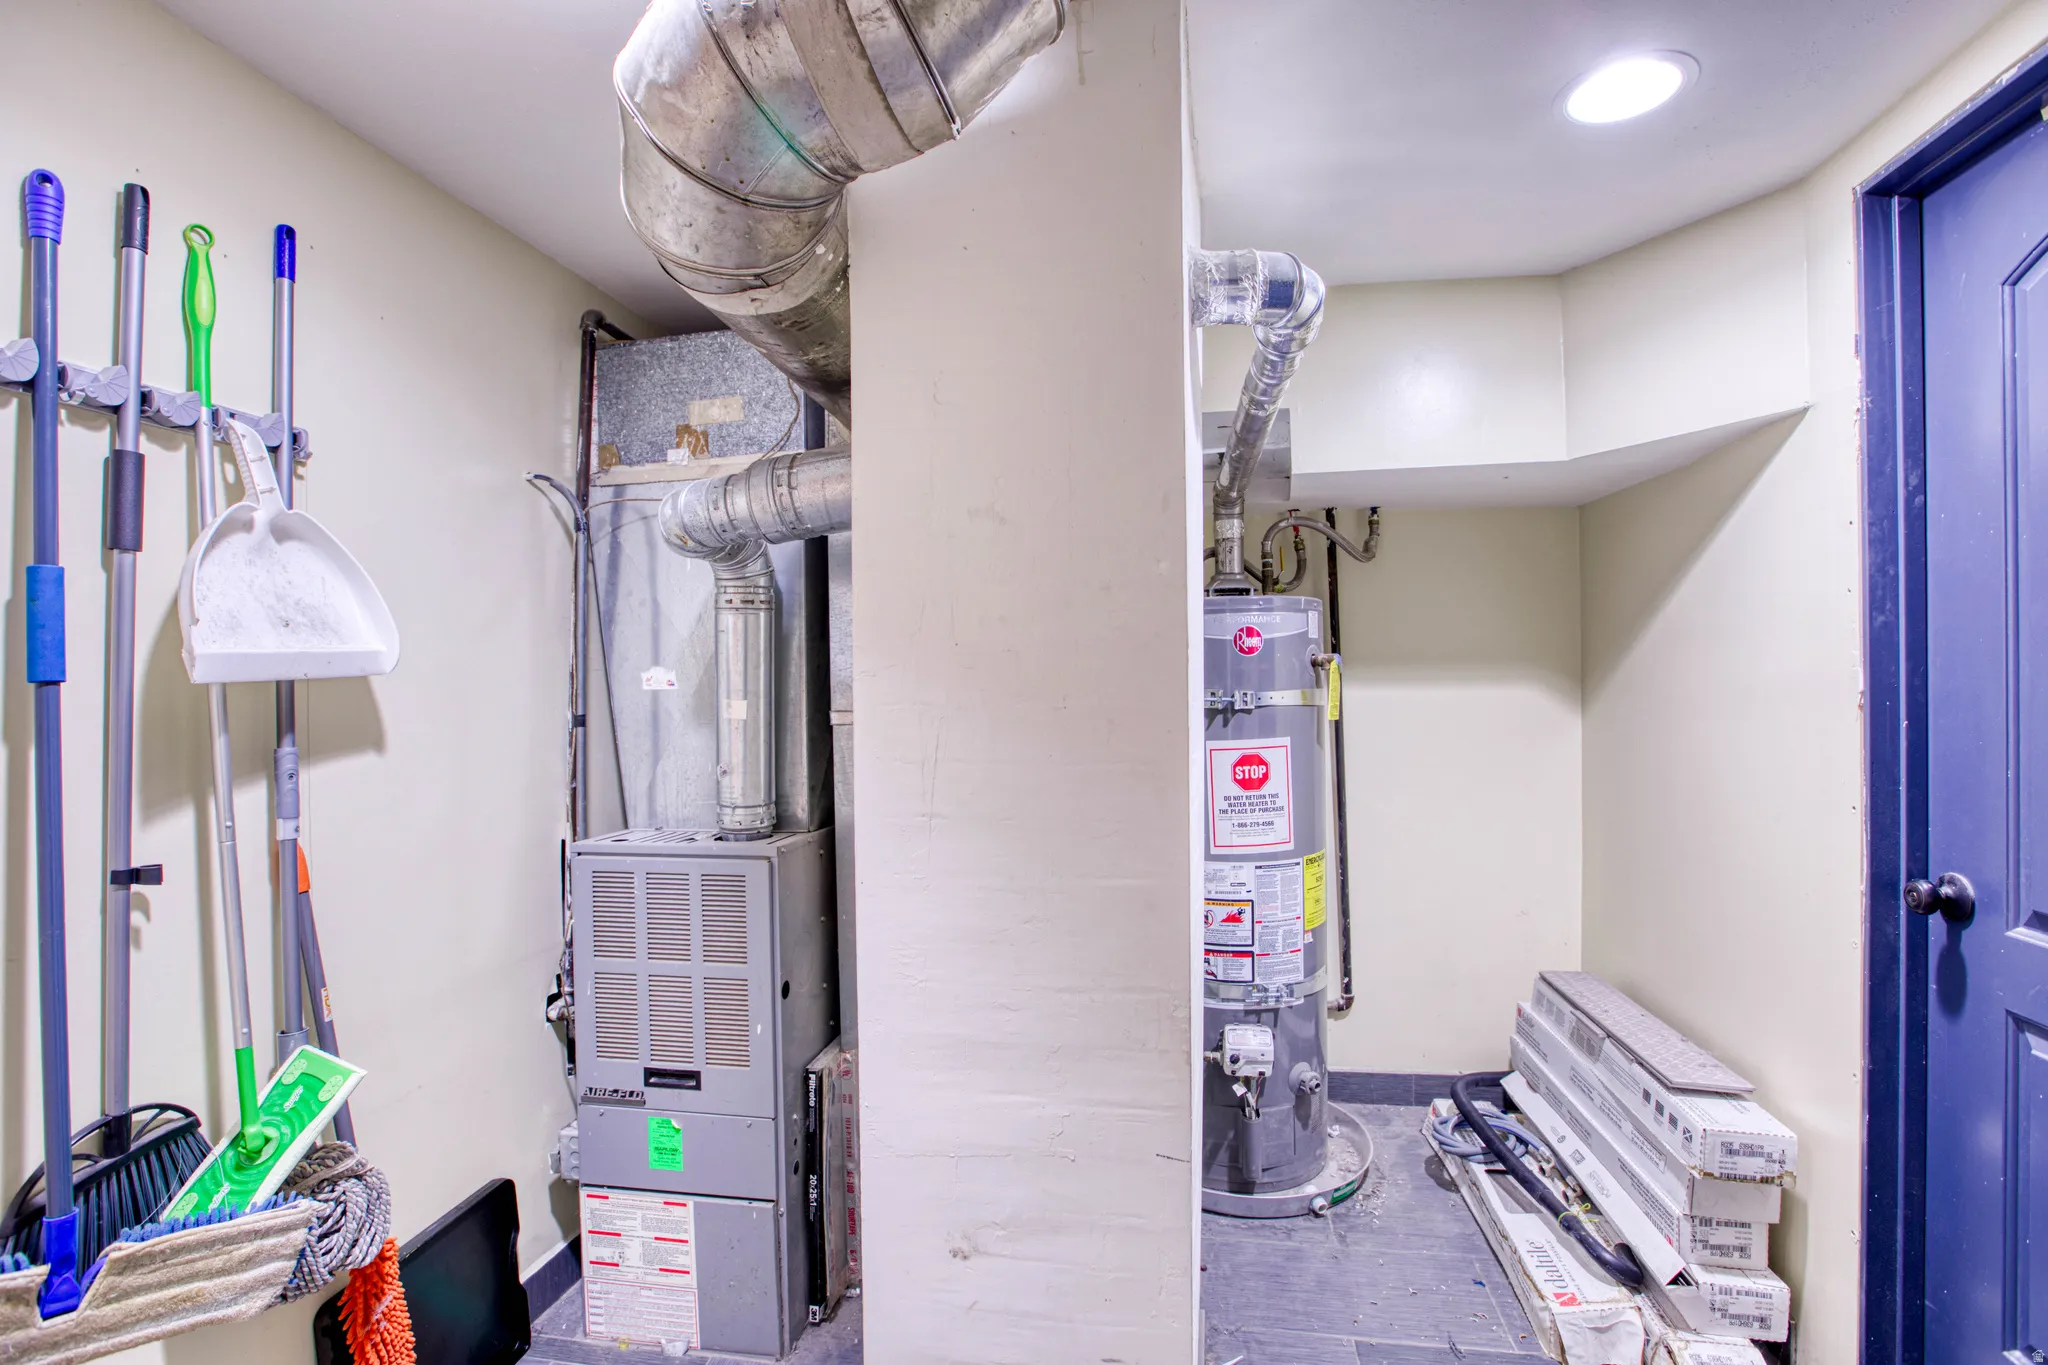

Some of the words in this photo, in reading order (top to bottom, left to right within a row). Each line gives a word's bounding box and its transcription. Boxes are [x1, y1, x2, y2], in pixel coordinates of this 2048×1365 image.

[1236, 626, 1262, 652] Rheem
[1235, 765, 1267, 780] STOP
[808, 1074, 816, 1107] Filtrete
[1526, 1241, 1568, 1289] daltile
[811, 1307, 818, 1322] 3M
